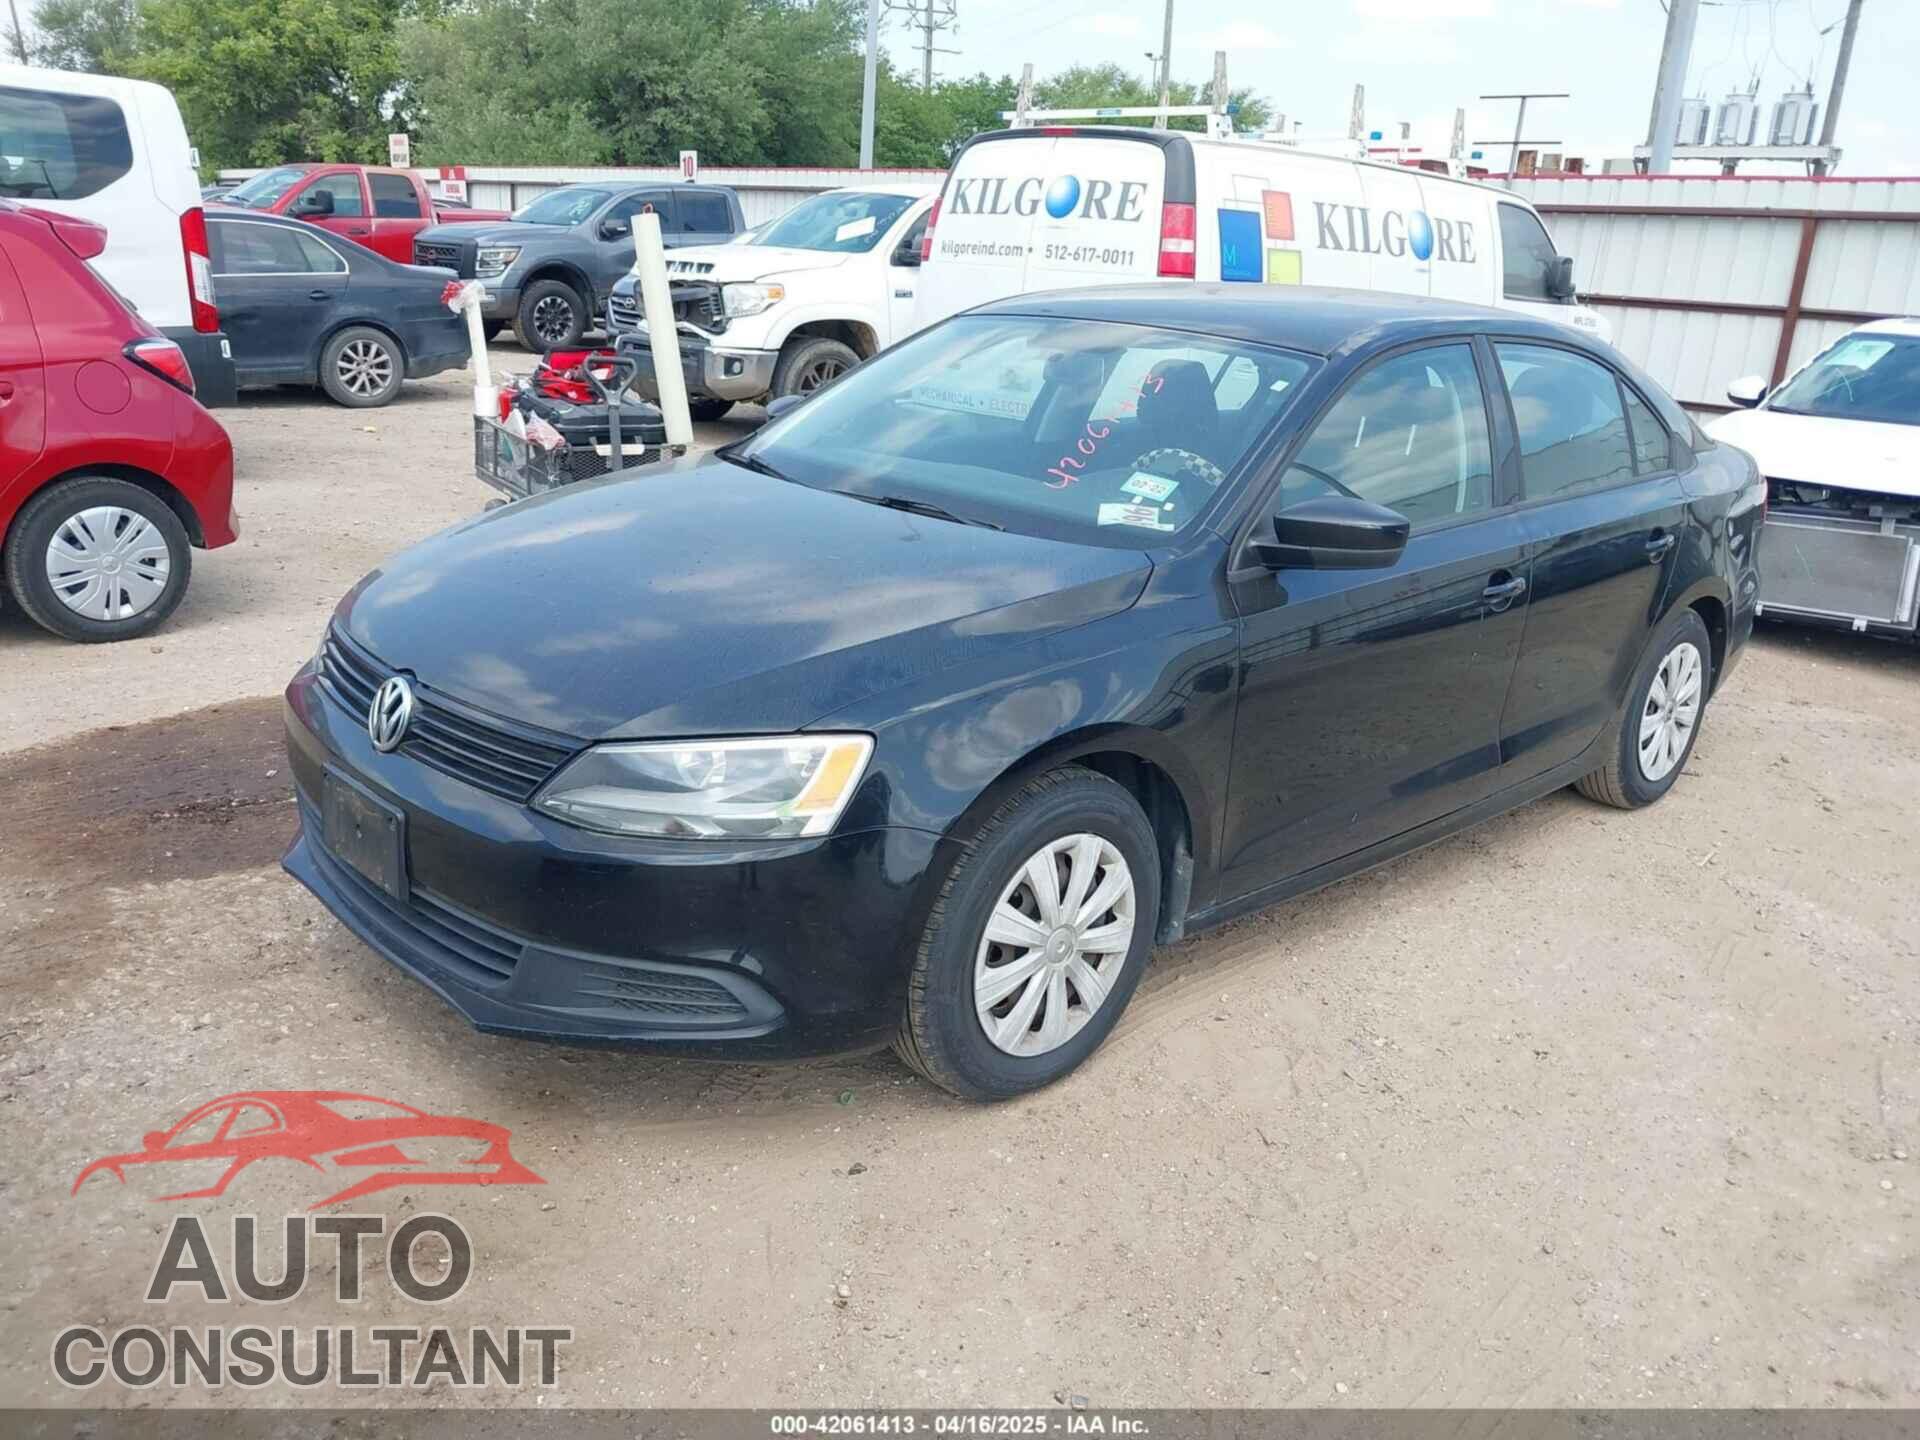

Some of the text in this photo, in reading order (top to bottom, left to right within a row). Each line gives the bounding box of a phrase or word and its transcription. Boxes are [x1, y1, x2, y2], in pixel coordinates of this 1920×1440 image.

[683, 156, 694, 177] 10
[949, 175, 1148, 222] KILGORE
[1312, 201, 1477, 264] KILGORE
[941, 240, 1135, 266] kilgoreind.com 512-617-0011
